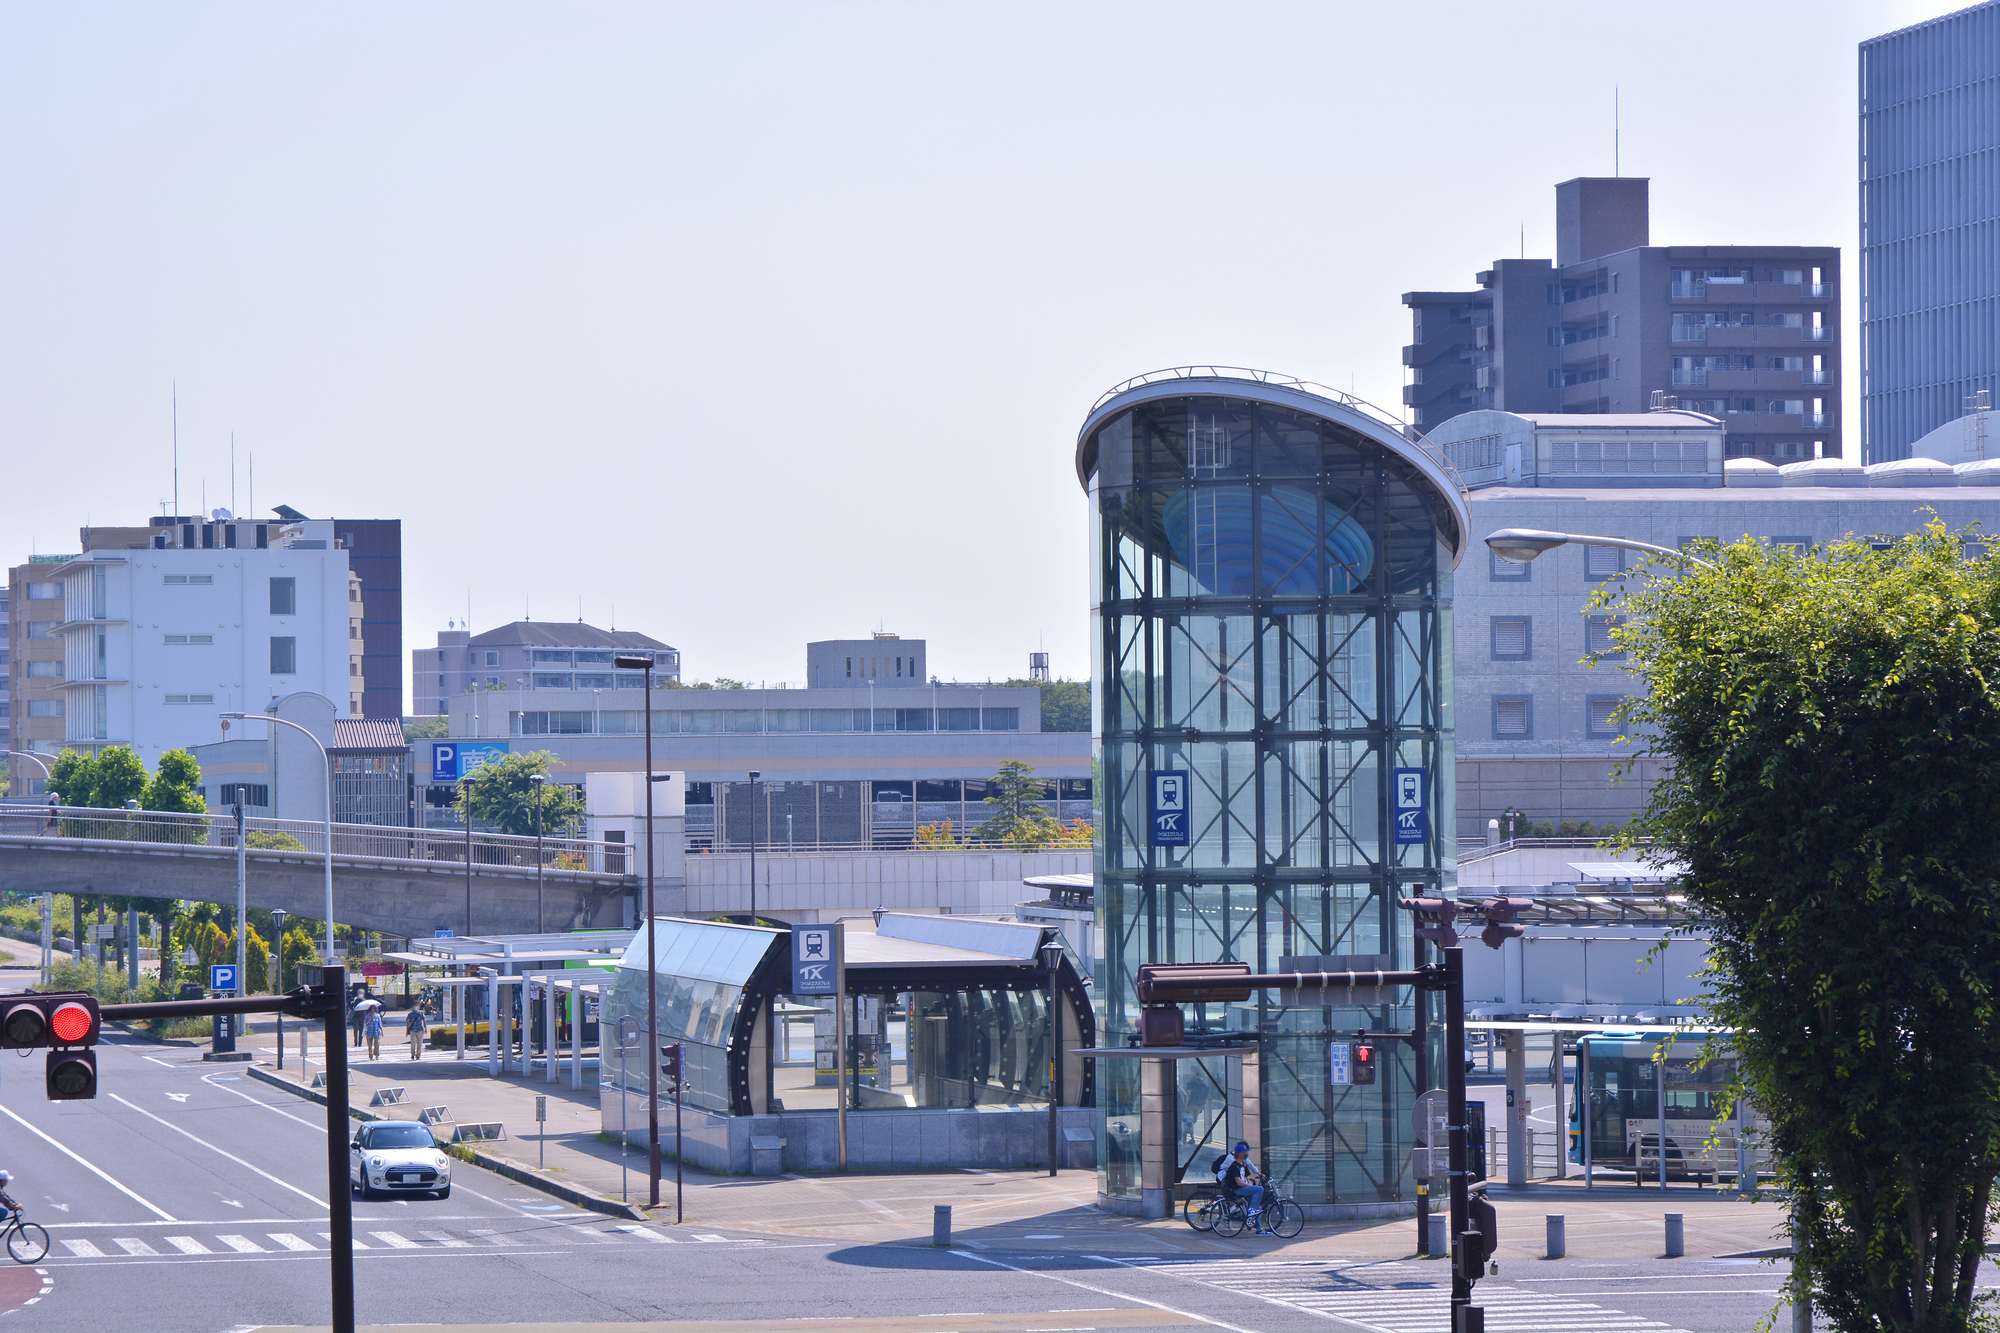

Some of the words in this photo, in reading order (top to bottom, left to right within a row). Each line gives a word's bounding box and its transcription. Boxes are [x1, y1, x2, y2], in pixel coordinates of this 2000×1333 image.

[436, 747, 454, 771] P
[1156, 813, 1183, 830] TX
[1398, 811, 1421, 828] TX
[216, 968, 233, 987] P
[799, 964, 829, 980] TX
